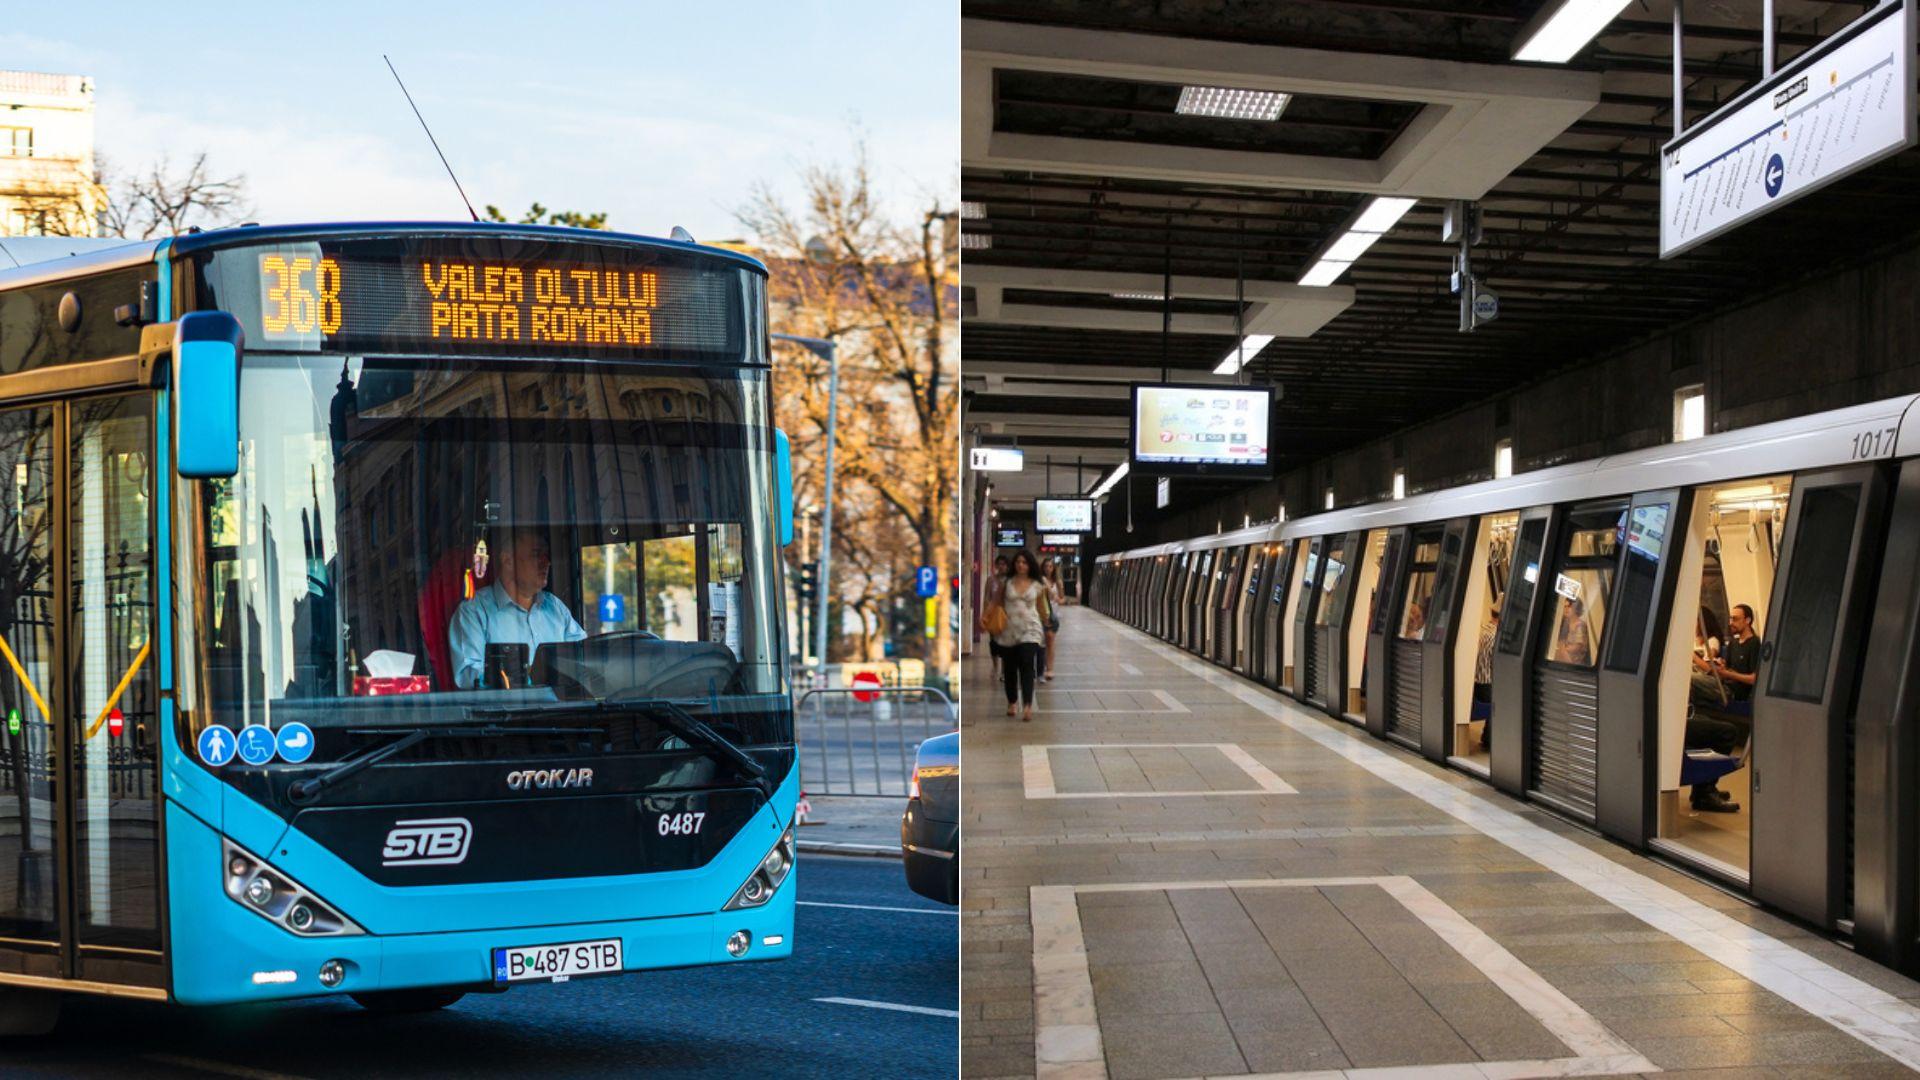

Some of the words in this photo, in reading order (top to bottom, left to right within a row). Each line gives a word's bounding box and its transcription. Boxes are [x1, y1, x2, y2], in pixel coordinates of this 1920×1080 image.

[263, 256, 342, 335] 368
[423, 264, 523, 303] VALEA
[535, 268, 657, 308] OLTULUI
[432, 303, 520, 340] PIATA
[531, 306, 652, 344] ROMANA
[1852, 427, 1896, 460] 1017
[921, 567, 934, 591] P
[507, 768, 593, 790] OTOKAR
[657, 812, 705, 836] 6487
[382, 829, 463, 859] STB
[509, 952, 526, 977] B
[534, 948, 570, 974] 487
[575, 943, 618, 970] STB
